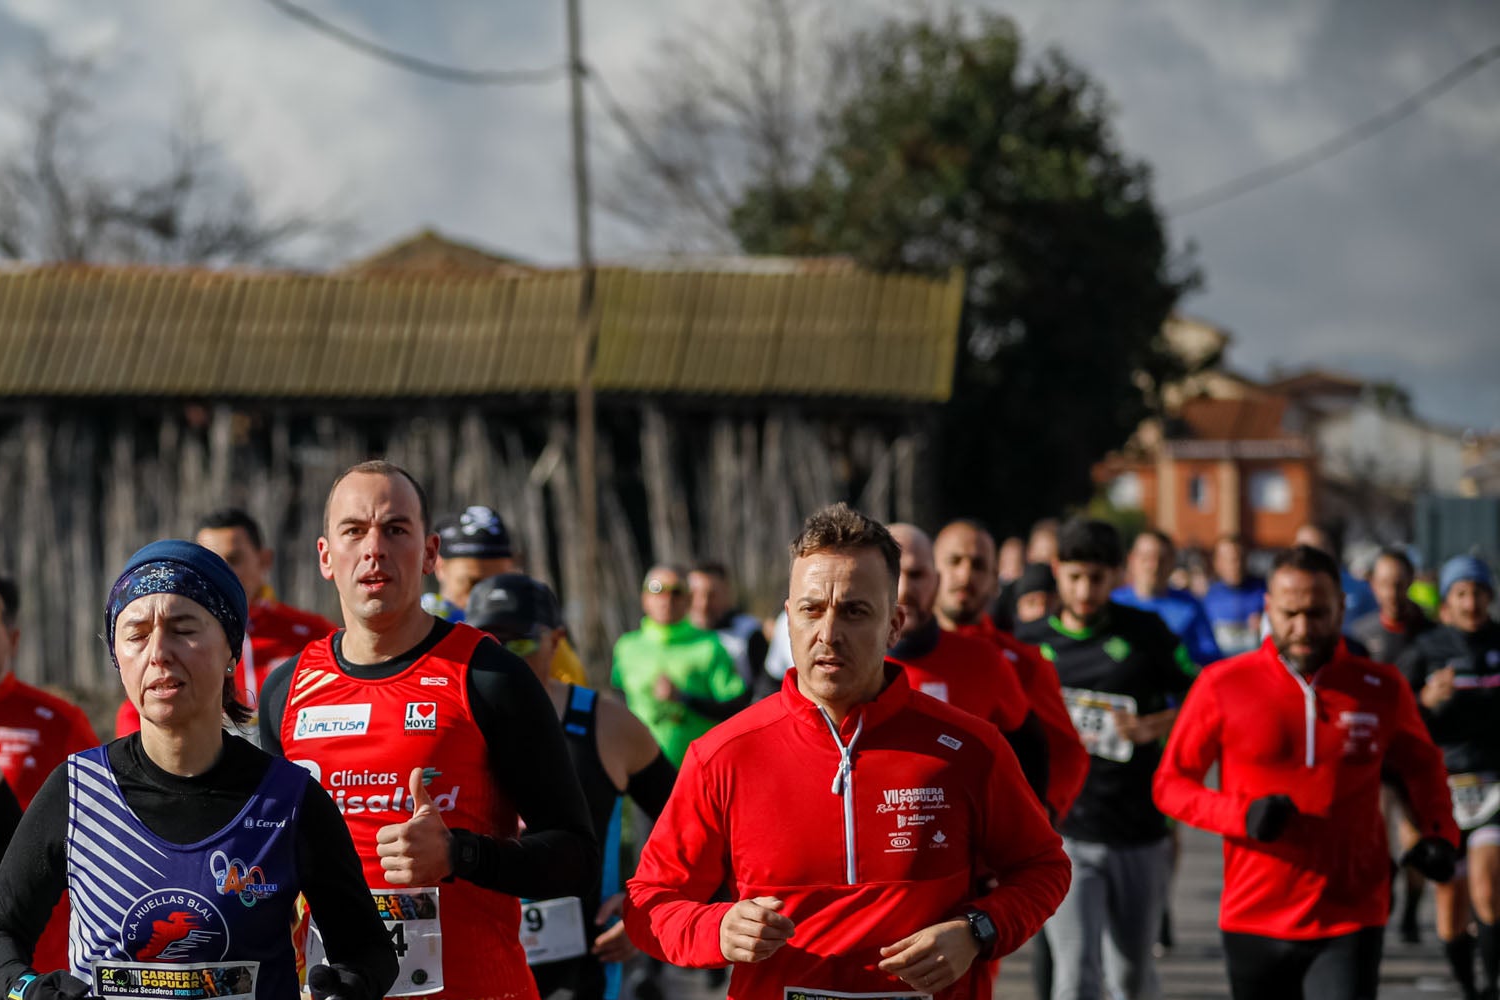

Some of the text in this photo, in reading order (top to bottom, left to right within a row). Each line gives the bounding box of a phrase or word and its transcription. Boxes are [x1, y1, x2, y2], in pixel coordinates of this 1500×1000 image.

[405, 719, 436, 728] MOVE
[330, 769, 398, 787] Clínicas
[883, 789, 899, 805] VII
[899, 788, 944, 796] CARRERA
[899, 795, 945, 804] POPULAR
[893, 838, 908, 847] KIA
[127, 895, 213, 940] C.A. HUELLAS BLAL
[141, 970, 200, 981] CARRERA
[142, 979, 200, 988] POPULAR
[102, 984, 118, 993] Ruta
[140, 986, 173, 996] Secaderos
